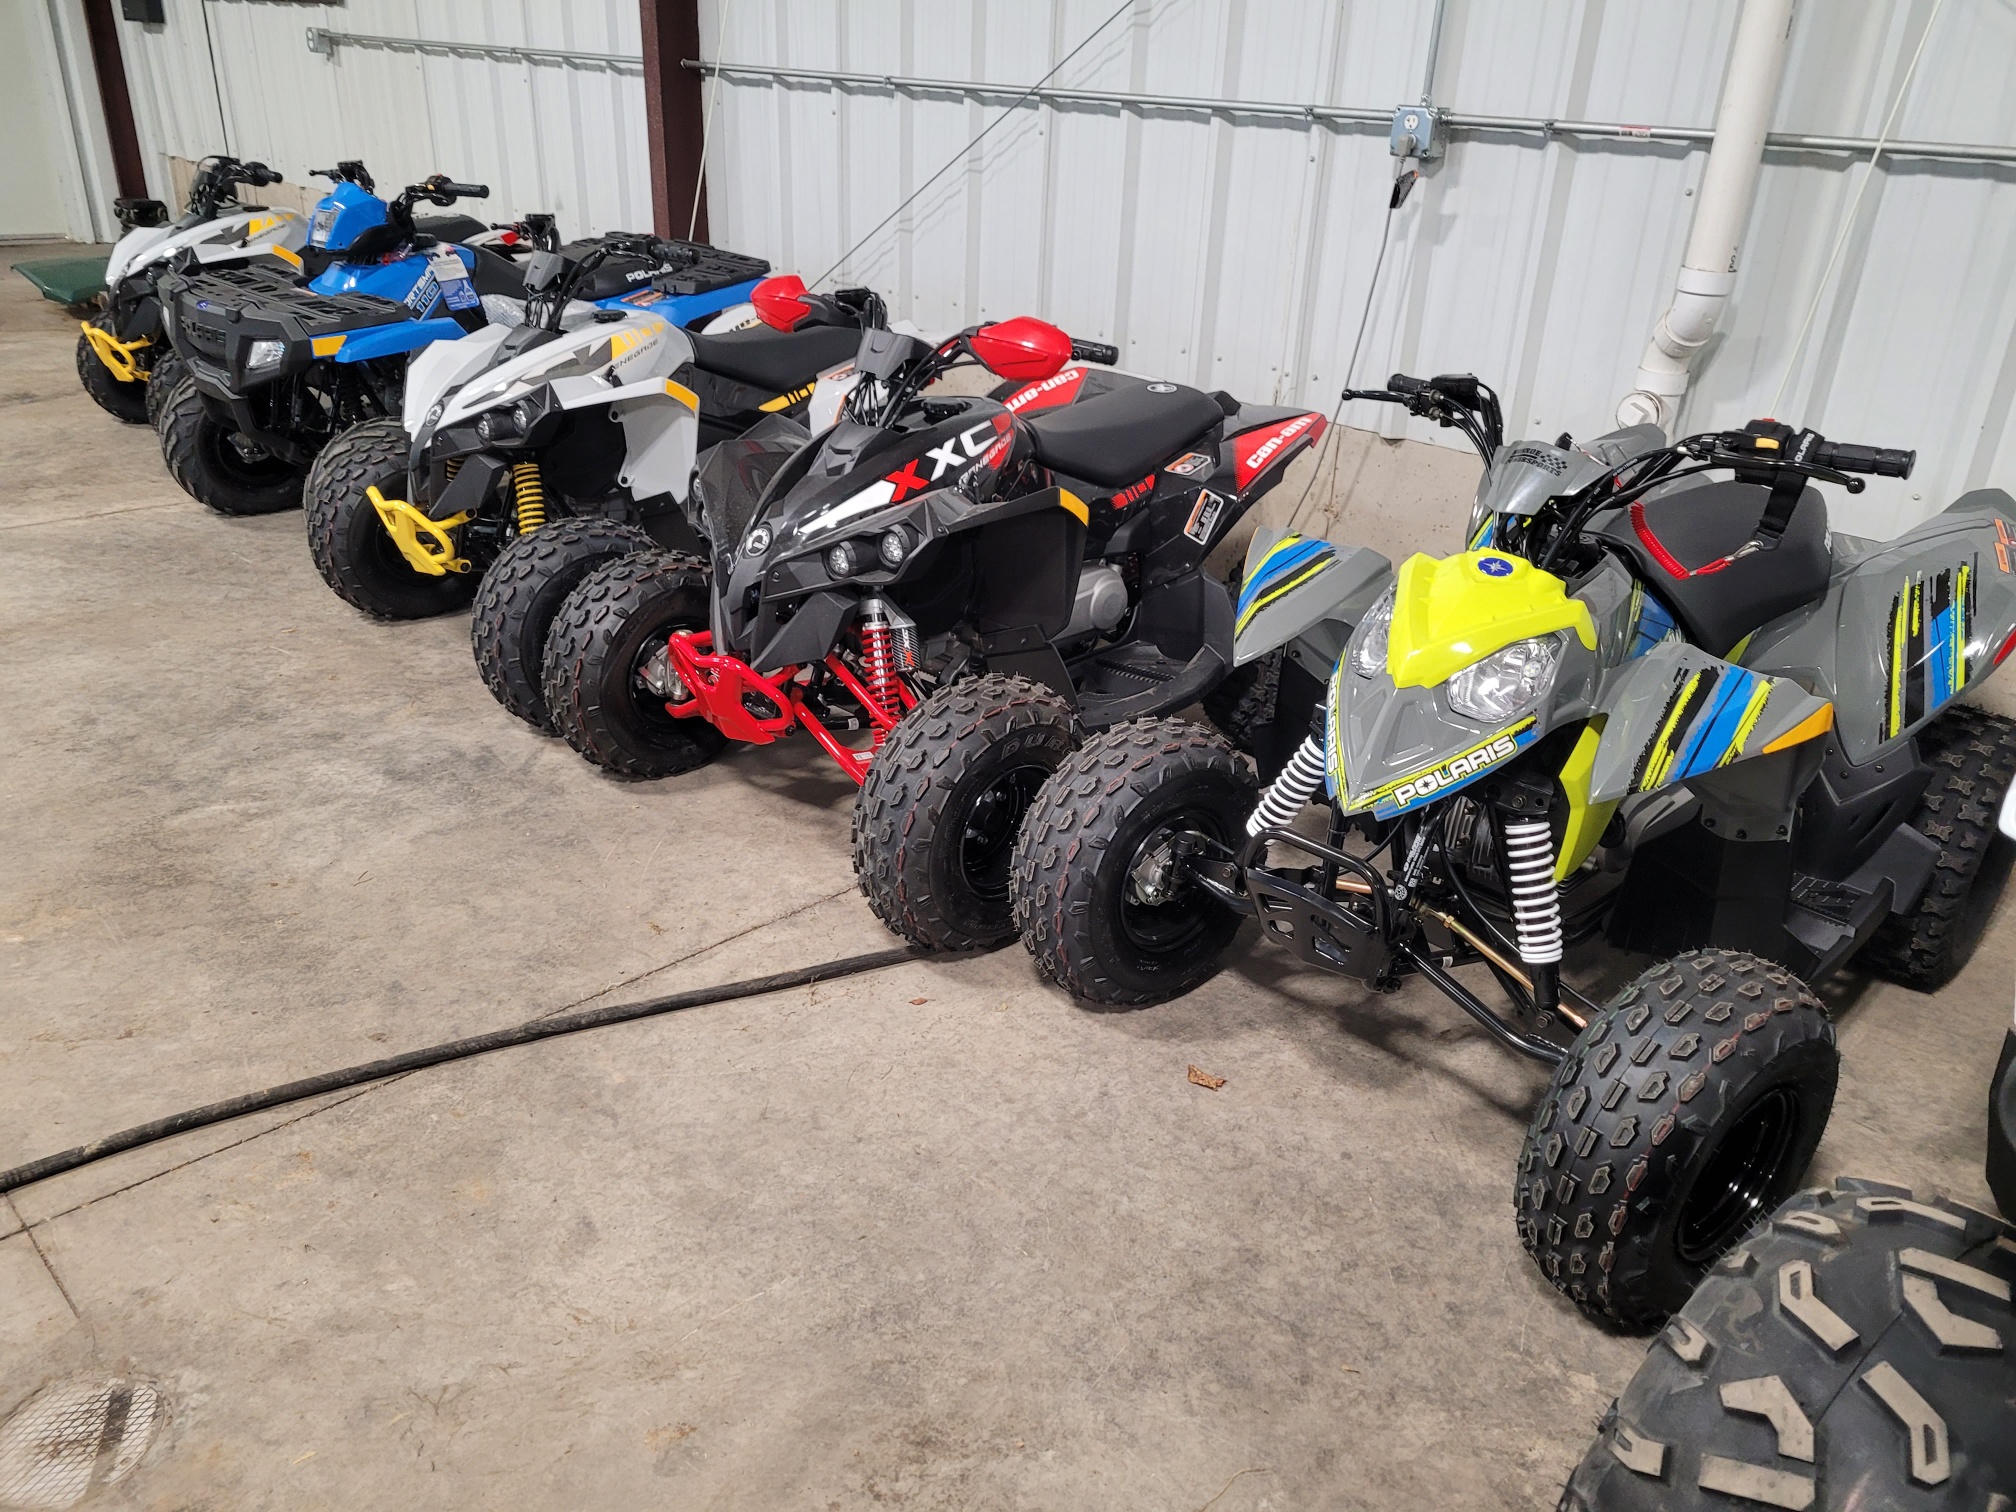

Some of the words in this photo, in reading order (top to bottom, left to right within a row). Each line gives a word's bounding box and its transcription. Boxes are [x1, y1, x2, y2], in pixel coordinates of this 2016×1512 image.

[416, 281, 440, 313] 110
[614, 339, 659, 367] ENEGADE
[884, 418, 999, 503] XXC
[1245, 416, 1313, 469] can-am
[1794, 432, 1815, 462] OLARIS
[1327, 671, 1340, 775] POLARIS
[1001, 732, 1072, 760] DUR
[1394, 734, 1516, 806] POLARIS
